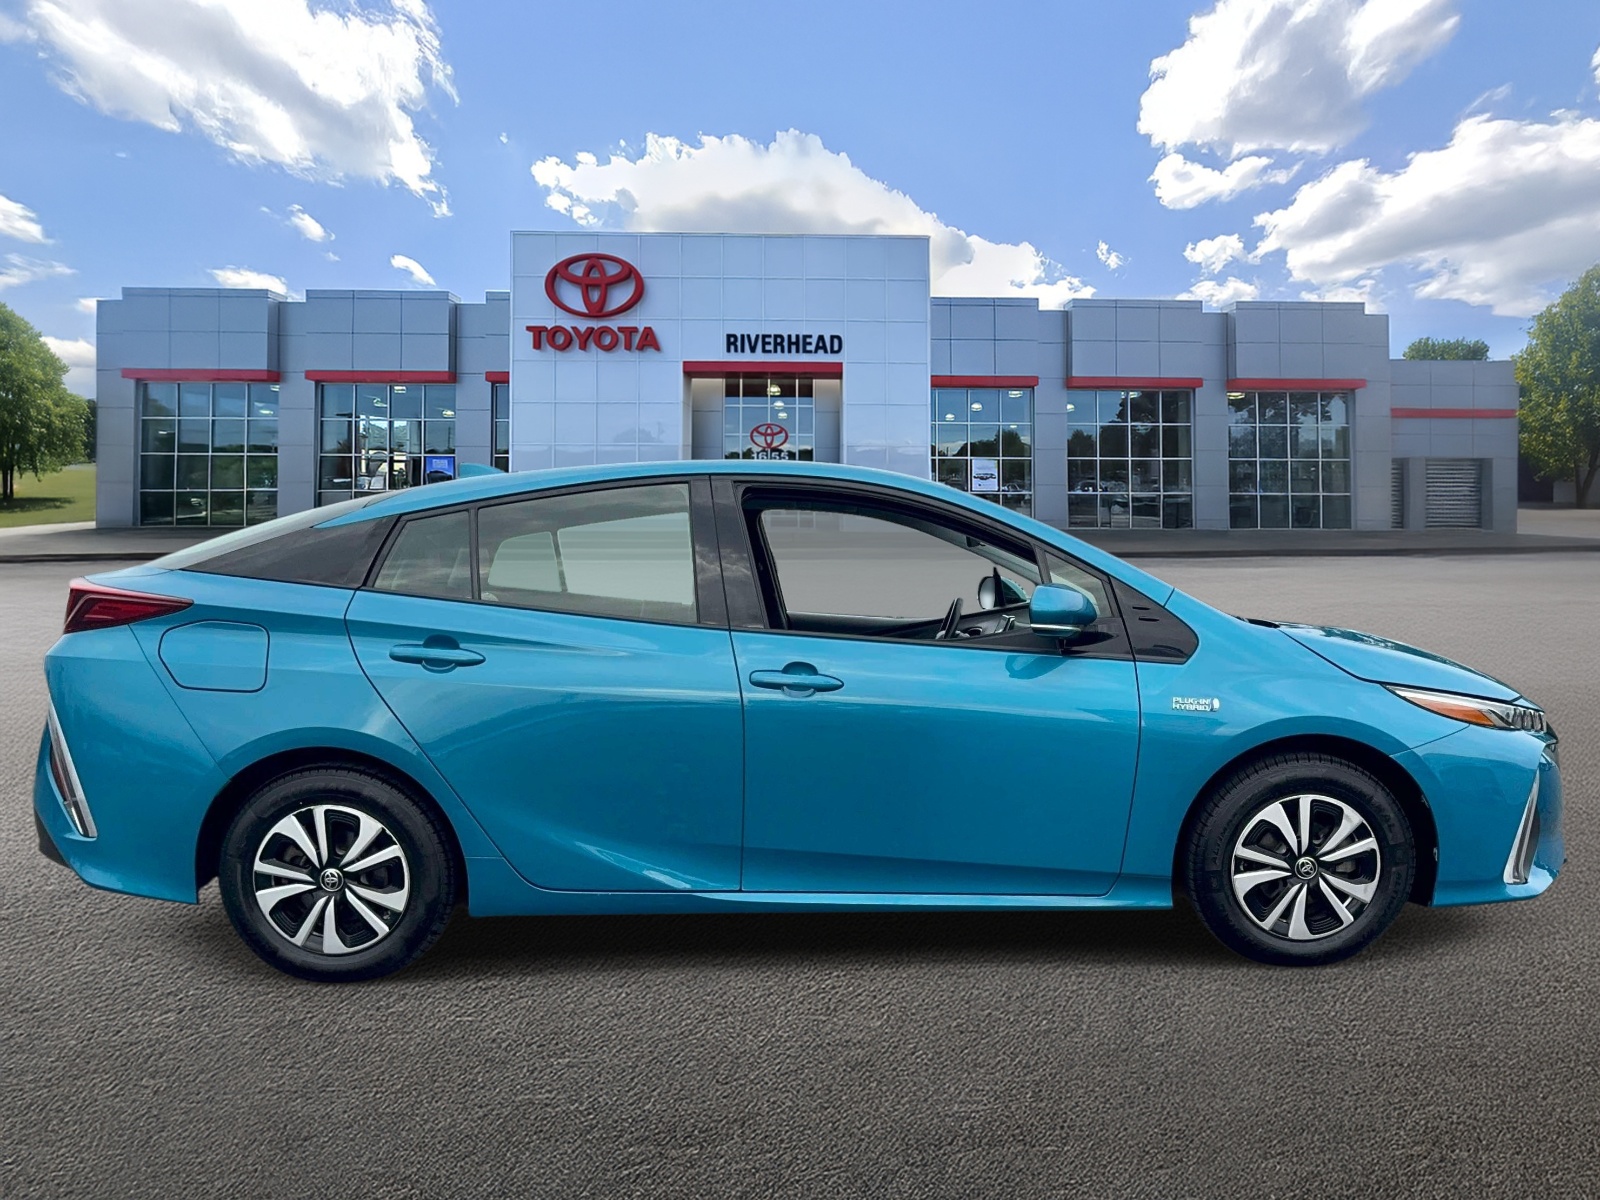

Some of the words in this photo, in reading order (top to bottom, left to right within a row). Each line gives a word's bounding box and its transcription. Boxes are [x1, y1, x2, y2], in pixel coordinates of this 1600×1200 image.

[525, 325, 661, 352] TOYOTA
[726, 333, 843, 355] RIVERHEAD
[1172, 696, 1209, 705] PLUG-IN
[1172, 703, 1209, 711] HYBRID
